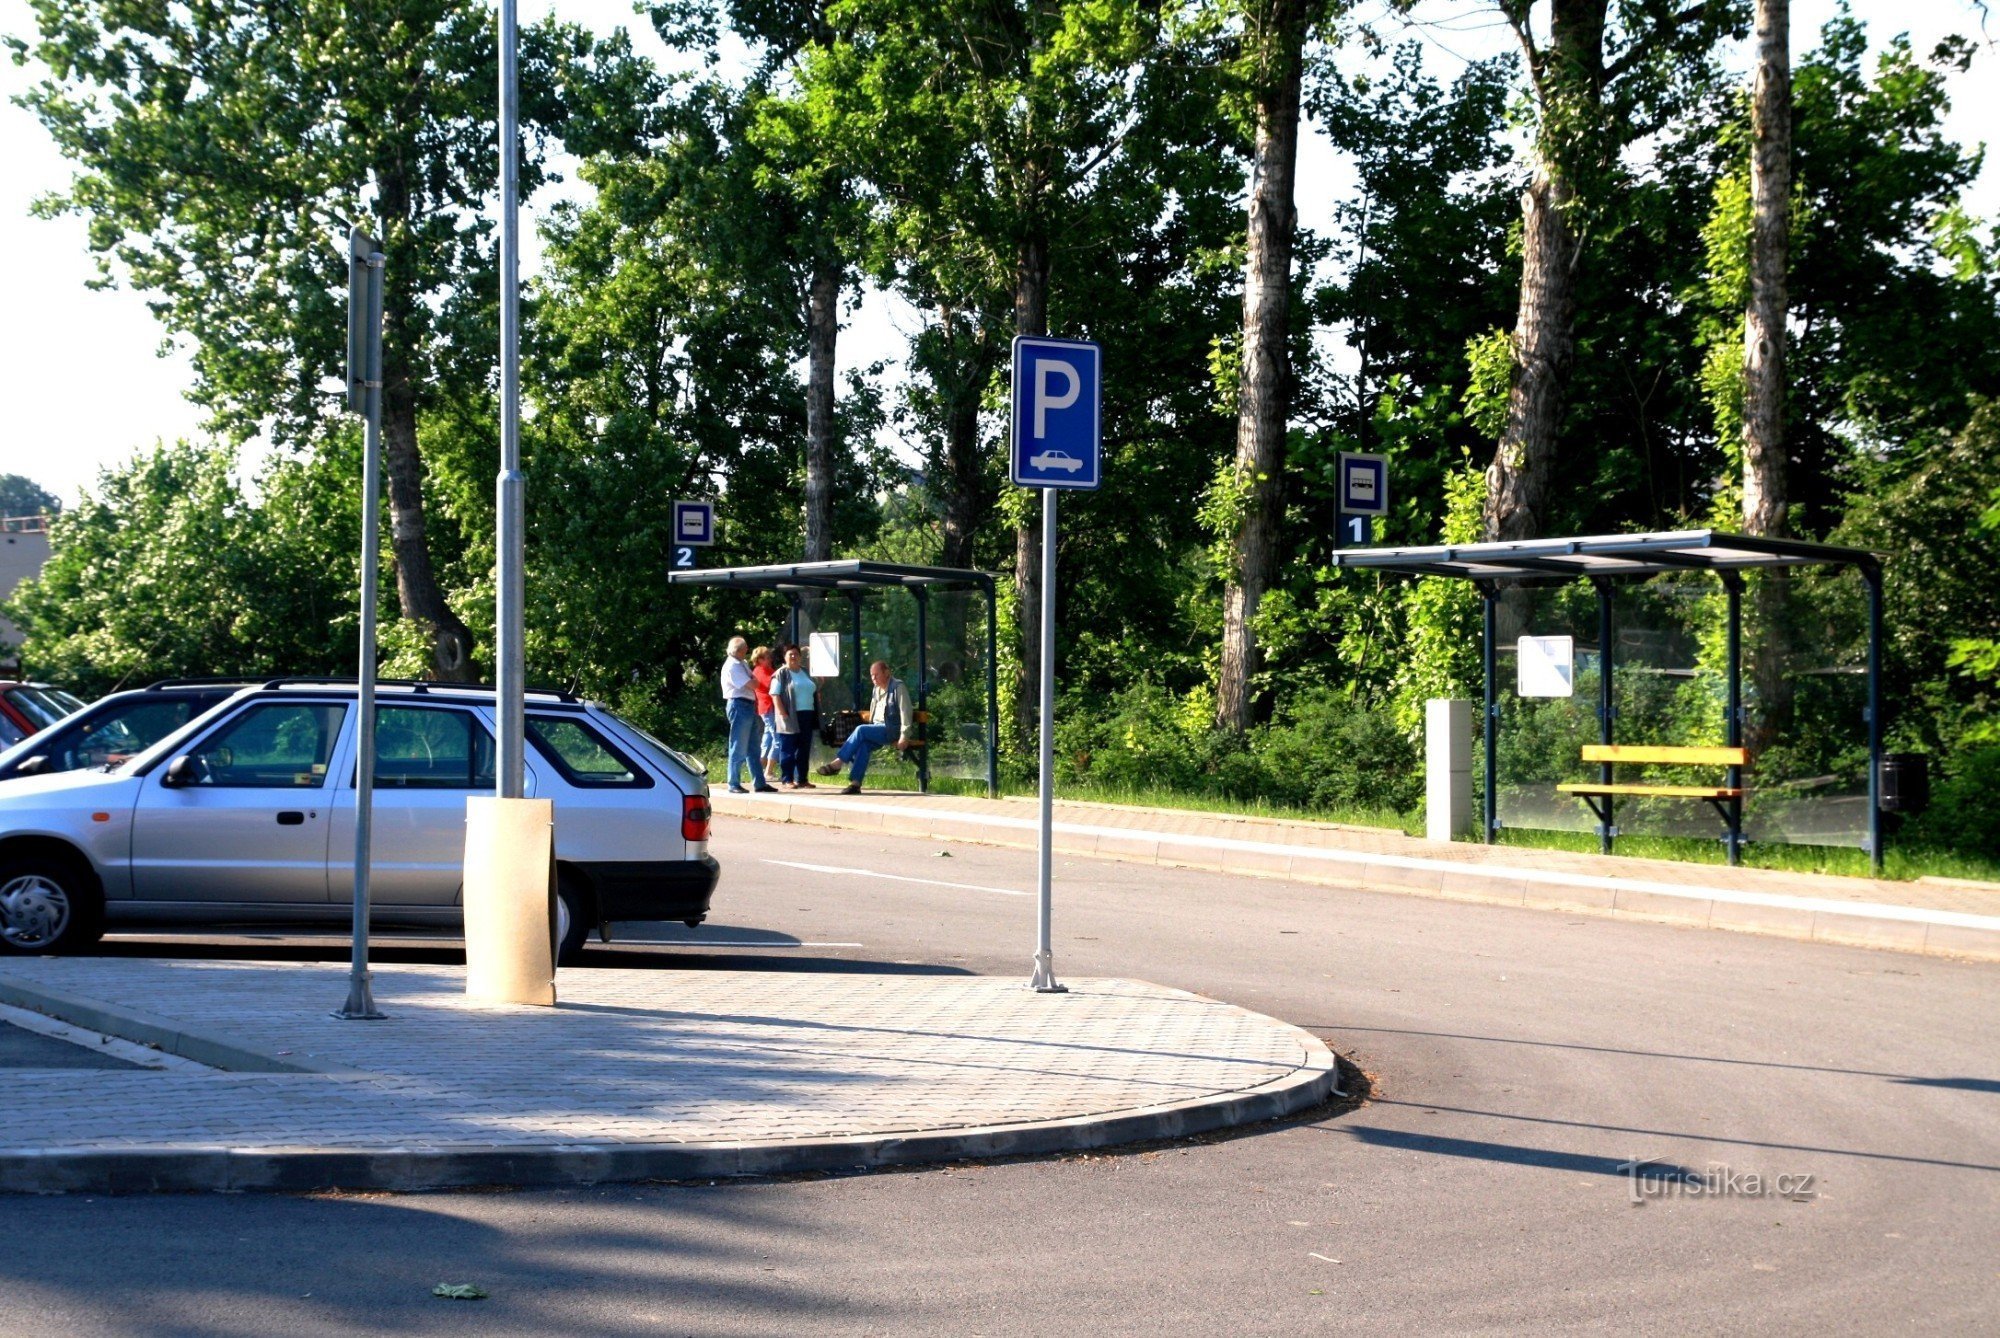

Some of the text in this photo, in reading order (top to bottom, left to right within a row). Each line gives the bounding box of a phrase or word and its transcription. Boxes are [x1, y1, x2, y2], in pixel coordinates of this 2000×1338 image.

[1034, 358, 1081, 439] P
[1348, 517, 1362, 542] 1
[677, 547, 692, 566] 2
